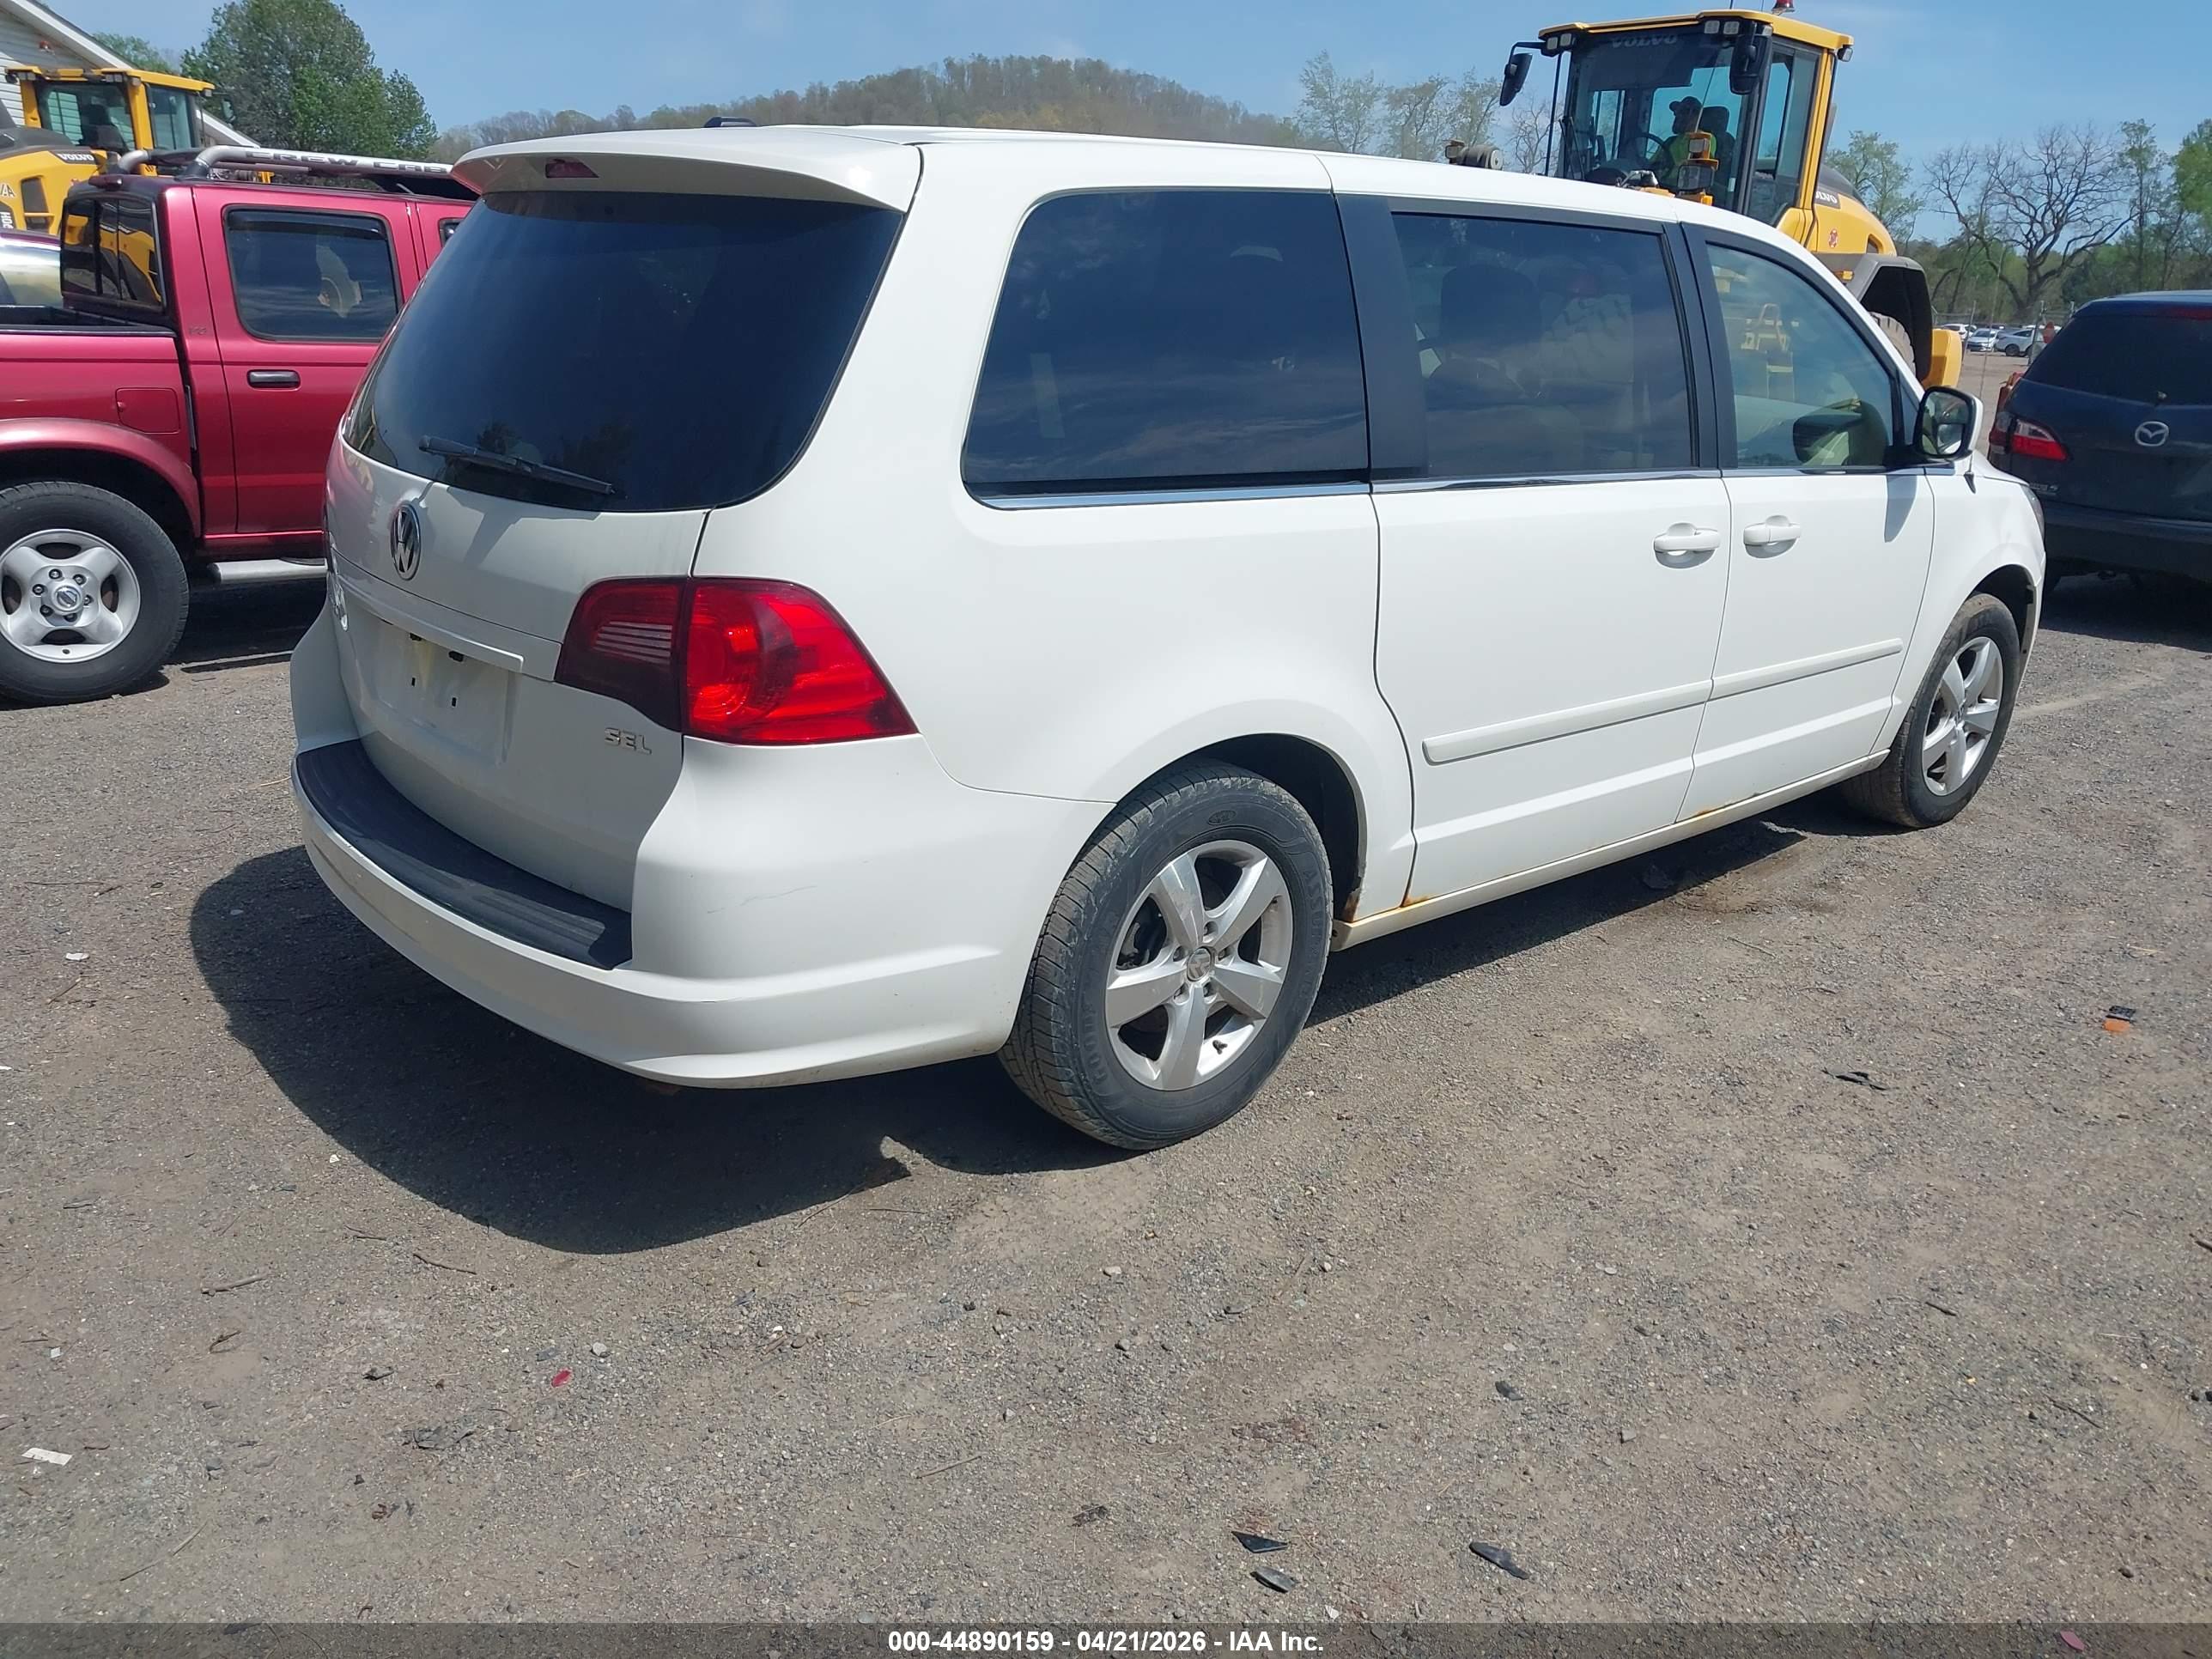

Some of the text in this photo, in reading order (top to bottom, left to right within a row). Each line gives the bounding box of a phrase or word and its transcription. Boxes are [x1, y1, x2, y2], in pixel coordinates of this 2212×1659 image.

[246, 151, 447, 173] CREW CAB
[605, 727, 653, 756] SEL
